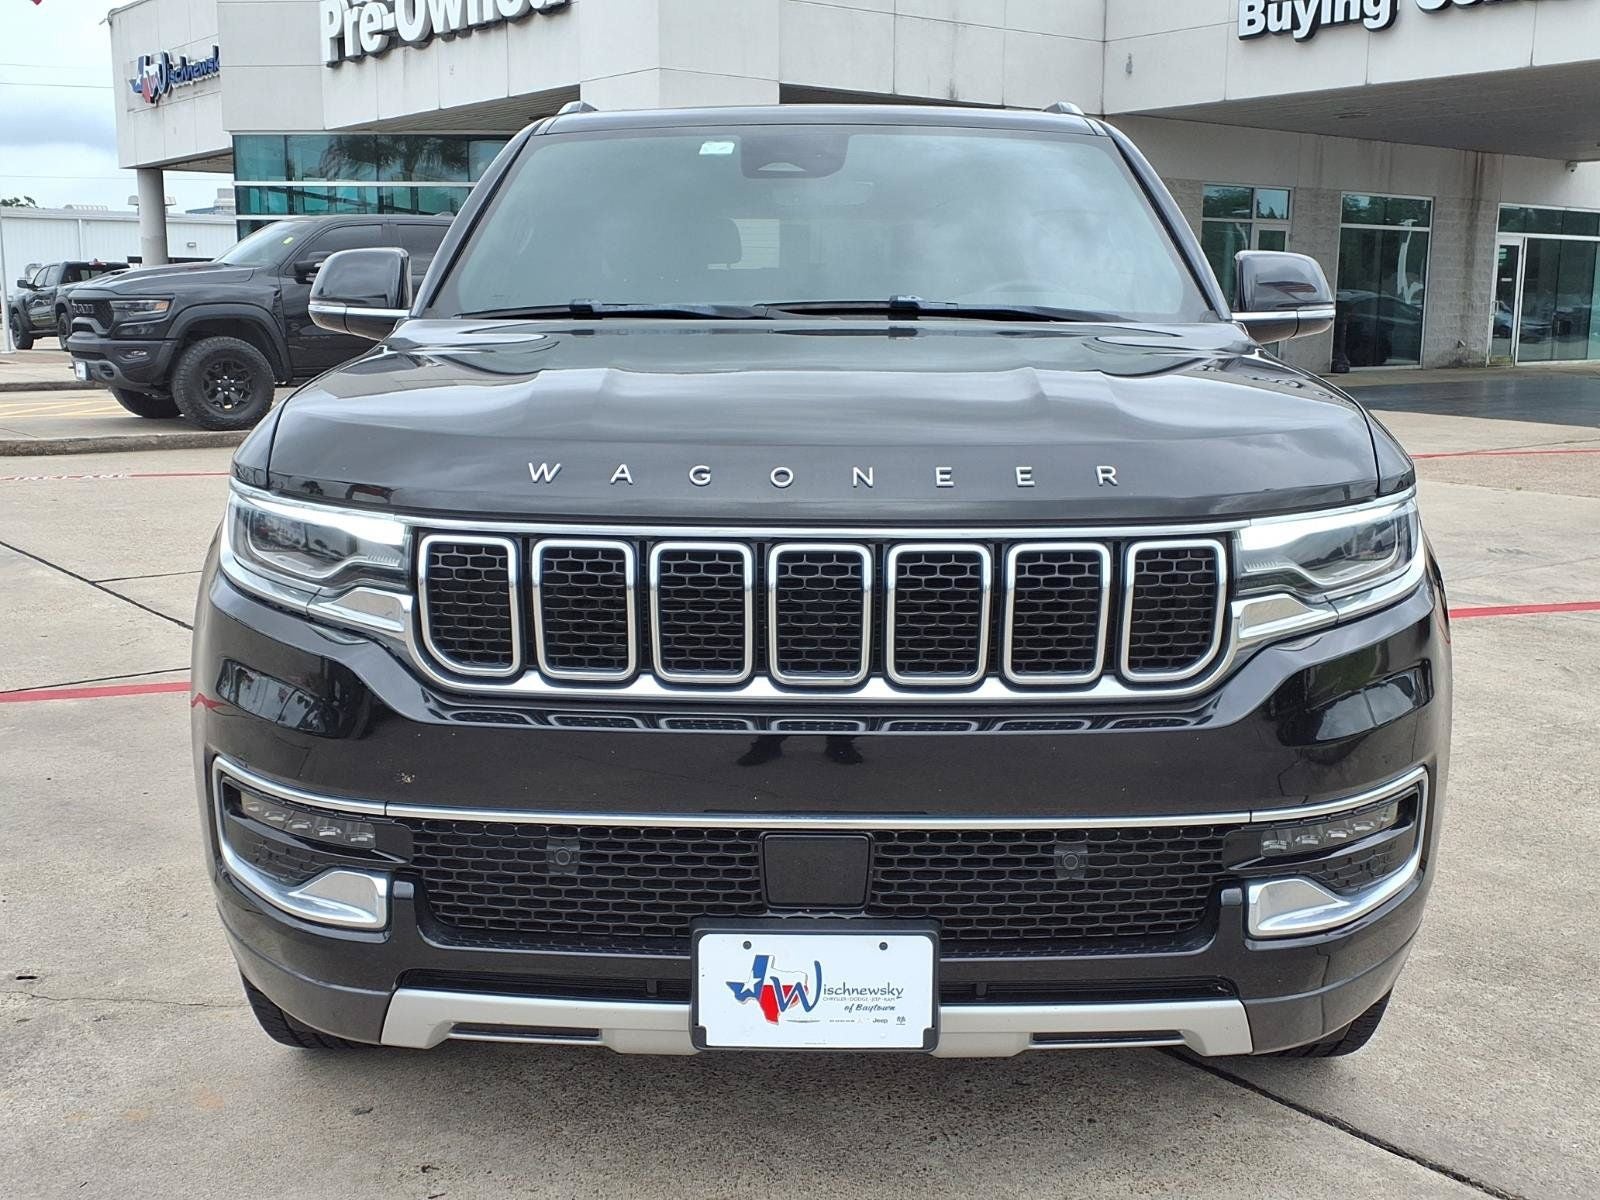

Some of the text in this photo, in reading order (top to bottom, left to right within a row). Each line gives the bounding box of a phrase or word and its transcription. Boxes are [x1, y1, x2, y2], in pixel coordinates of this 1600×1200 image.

[320, 0, 566, 62] Pre-Own
[1238, 0, 1398, 42] Buying
[145, 45, 220, 95] Wischnewsk
[527, 461, 1120, 489] WAGONEER
[844, 1003, 896, 1014] of Baytown
